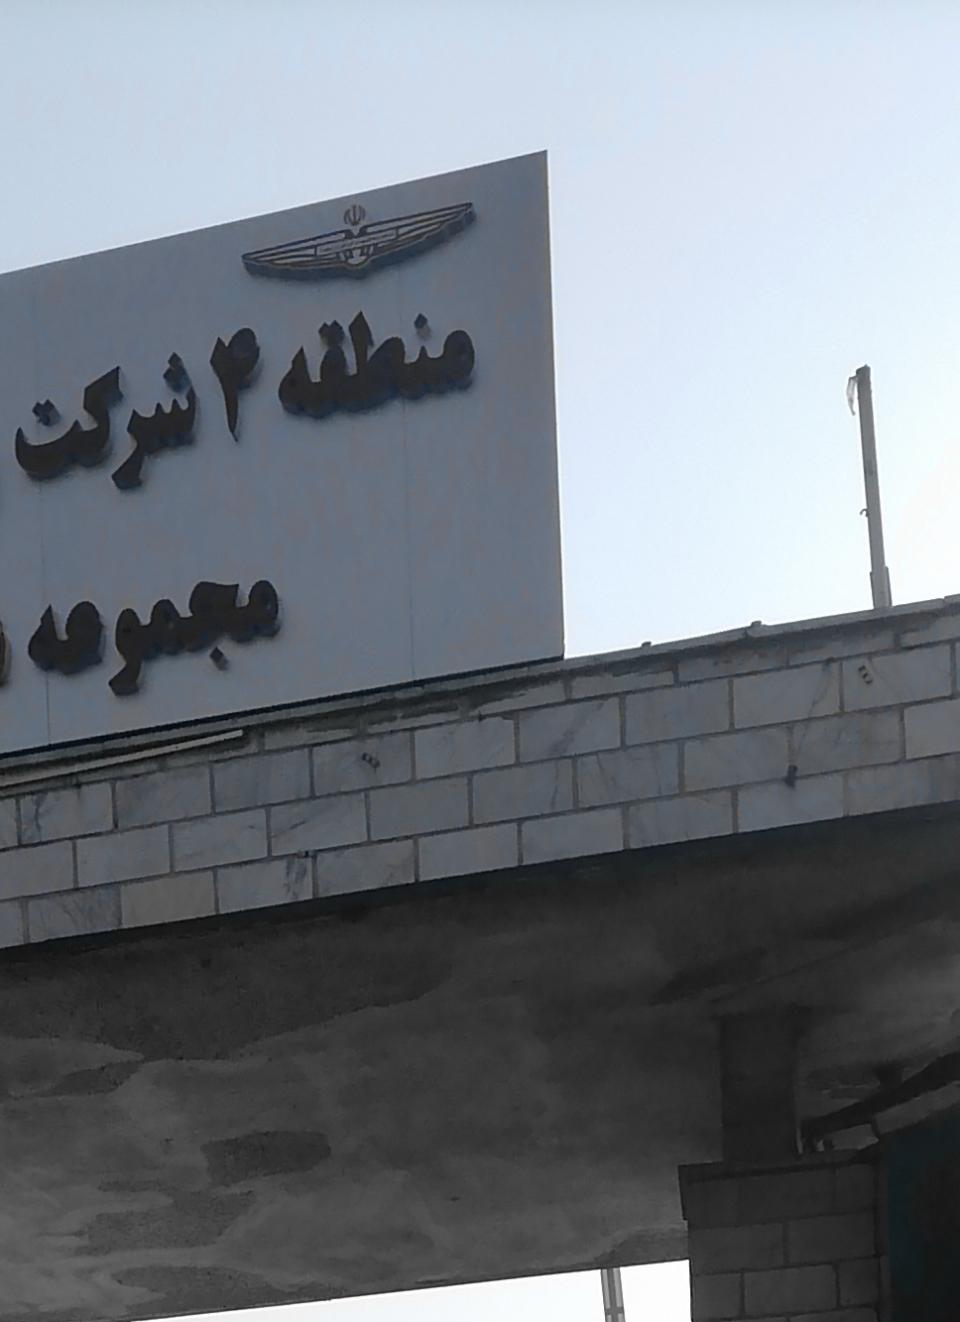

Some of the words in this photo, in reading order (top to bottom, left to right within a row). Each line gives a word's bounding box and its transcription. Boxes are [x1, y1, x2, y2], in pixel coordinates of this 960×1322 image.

[14, 352, 198, 490] شرکت
[209, 327, 259, 442] ۴
[278, 311, 476, 418] منطقه
[27, 579, 281, 696] مجموعه
